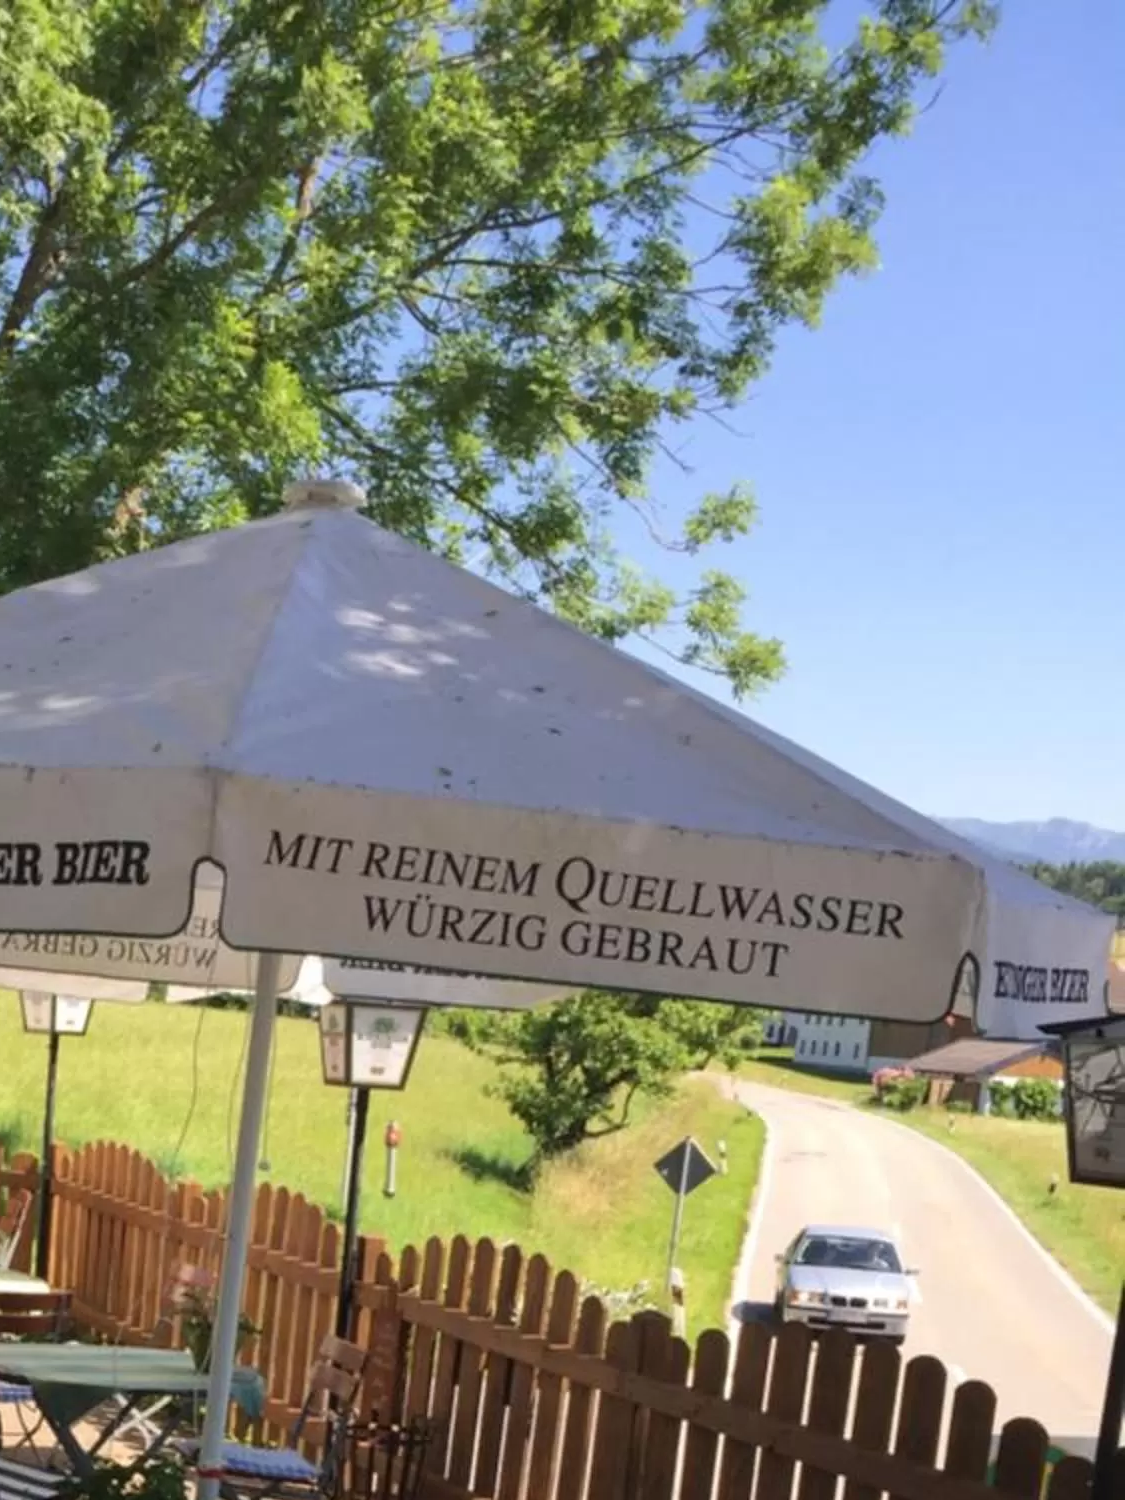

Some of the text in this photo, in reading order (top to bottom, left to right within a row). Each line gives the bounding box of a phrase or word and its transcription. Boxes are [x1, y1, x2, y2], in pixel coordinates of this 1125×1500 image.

[53, 840, 150, 885] BIER
[264, 829, 906, 940] MIT REINEM QUELLWASSER
[363, 893, 789, 979] WÜRZIG GEBRAUT
